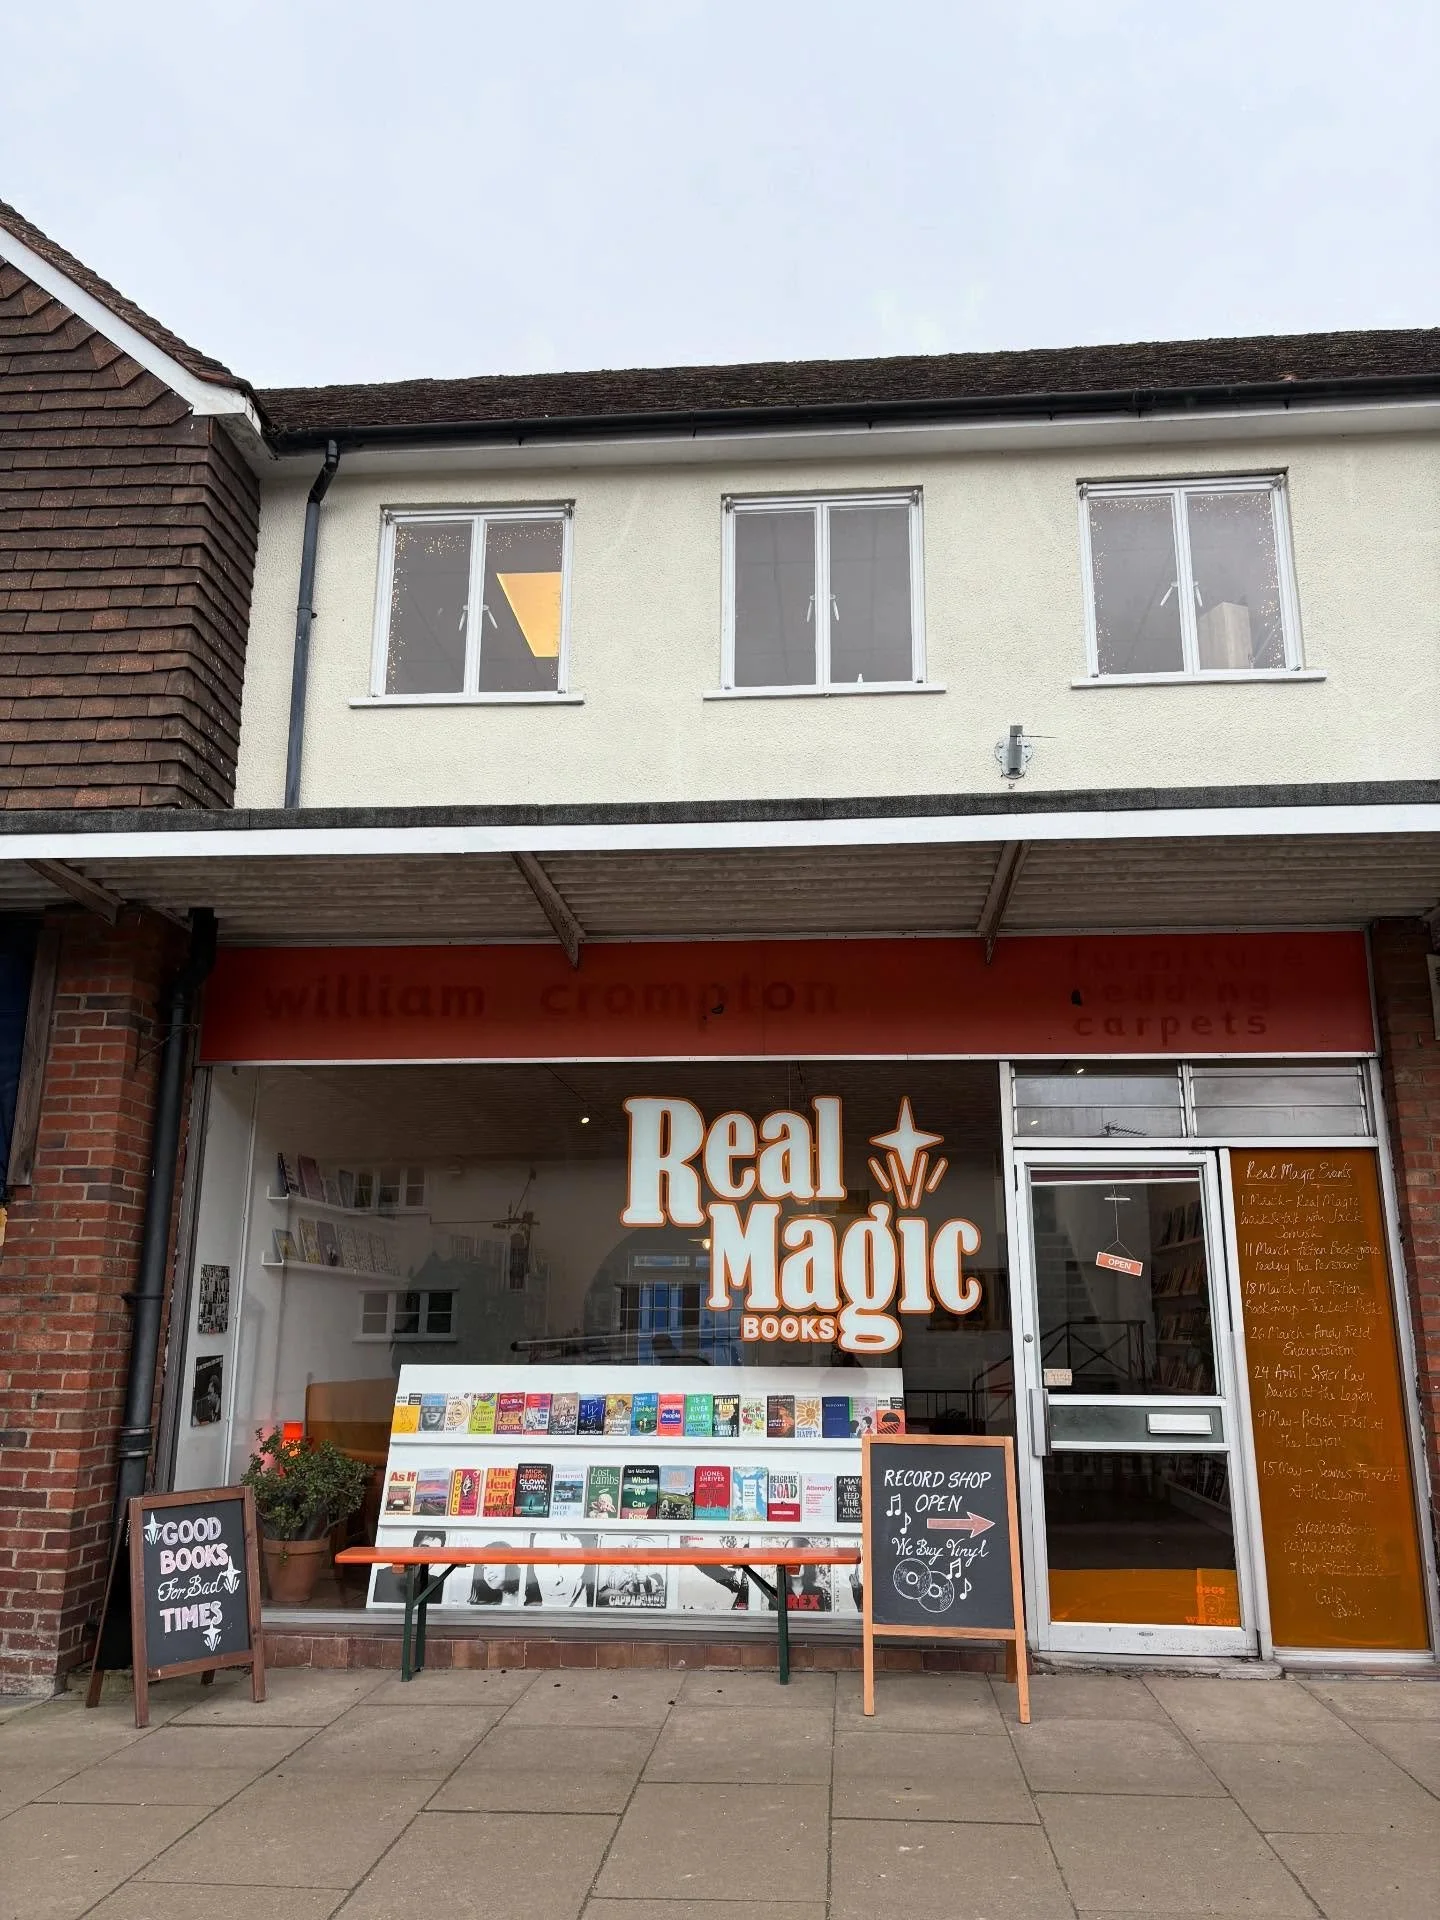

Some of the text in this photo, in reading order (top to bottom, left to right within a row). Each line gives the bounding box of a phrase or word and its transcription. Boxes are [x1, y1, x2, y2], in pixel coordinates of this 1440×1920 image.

[264, 970, 840, 1032] william crompton
[1073, 1011, 1269, 1046] carpets
[621, 1097, 847, 1226] Real
[1246, 1160, 1277, 1180] Real
[1281, 1162, 1315, 1192] Magic
[1296, 1194, 1319, 1208] Real
[1322, 1193, 1359, 1209] Magic
[1255, 1241, 1289, 1256] March
[1107, 1258, 1132, 1270] OPEN
[706, 1200, 982, 1353] Magic
[1246, 1281, 1256, 1295] 18
[741, 1317, 837, 1341] BOOKS
[1267, 1325, 1304, 1340] March
[1254, 1366, 1269, 1380] 24
[714, 1397, 739, 1405] WILLIAM
[797, 1430, 818, 1438] HAPPY
[391, 1472, 404, 1482] As
[407, 1472, 417, 1482] If
[592, 1468, 609, 1477] Lost
[770, 1475, 797, 1484] BELGRAVE
[884, 1469, 992, 1489] RECORD SHOP
[486, 1479, 516, 1489] dead
[591, 1476, 619, 1485] Lambs
[634, 1488, 645, 1496] We
[770, 1484, 798, 1499] ROAD
[843, 1492, 860, 1500] FEED
[632, 1500, 646, 1508] Can
[915, 1494, 962, 1513] OPEN
[161, 1517, 222, 1545] GOOD
[159, 1542, 229, 1575] BOOKS
[891, 1537, 989, 1567] We Buy Vinyl
[157, 1572, 225, 1602] For Bad
[786, 1594, 820, 1609] REX
[159, 1601, 223, 1633] TIMES
